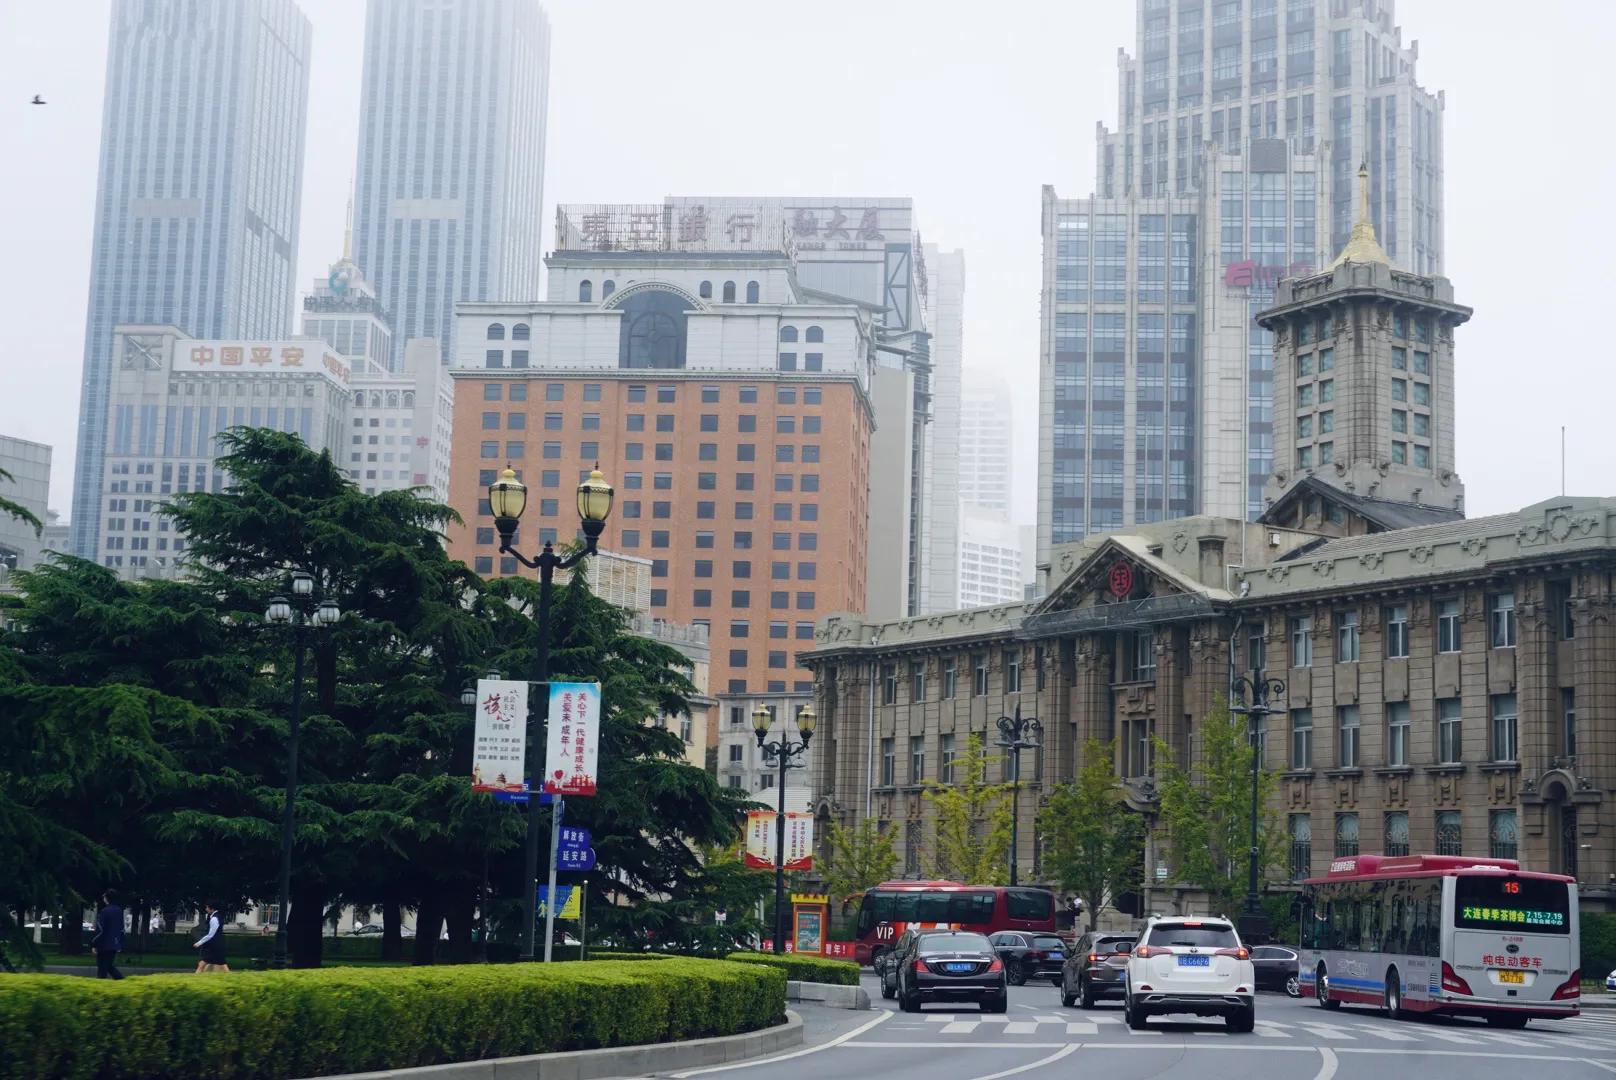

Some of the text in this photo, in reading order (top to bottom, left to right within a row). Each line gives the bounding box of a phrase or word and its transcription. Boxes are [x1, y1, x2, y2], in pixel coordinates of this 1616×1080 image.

[581, 205, 755, 243] 東亞銀行
[191, 345, 304, 367] 中国平安
[560, 693, 572, 758] 关爱未成年人
[574, 693, 587, 772] 关心下一代健康成长
[563, 830, 585, 842] 解放街
[562, 850, 587, 862] 延安路
[1504, 882, 1520, 893] 15
[1463, 907, 1525, 922] 大连春季茶博会
[876, 926, 894, 940] VIP
[1482, 955, 1543, 969] 纯电动客车
